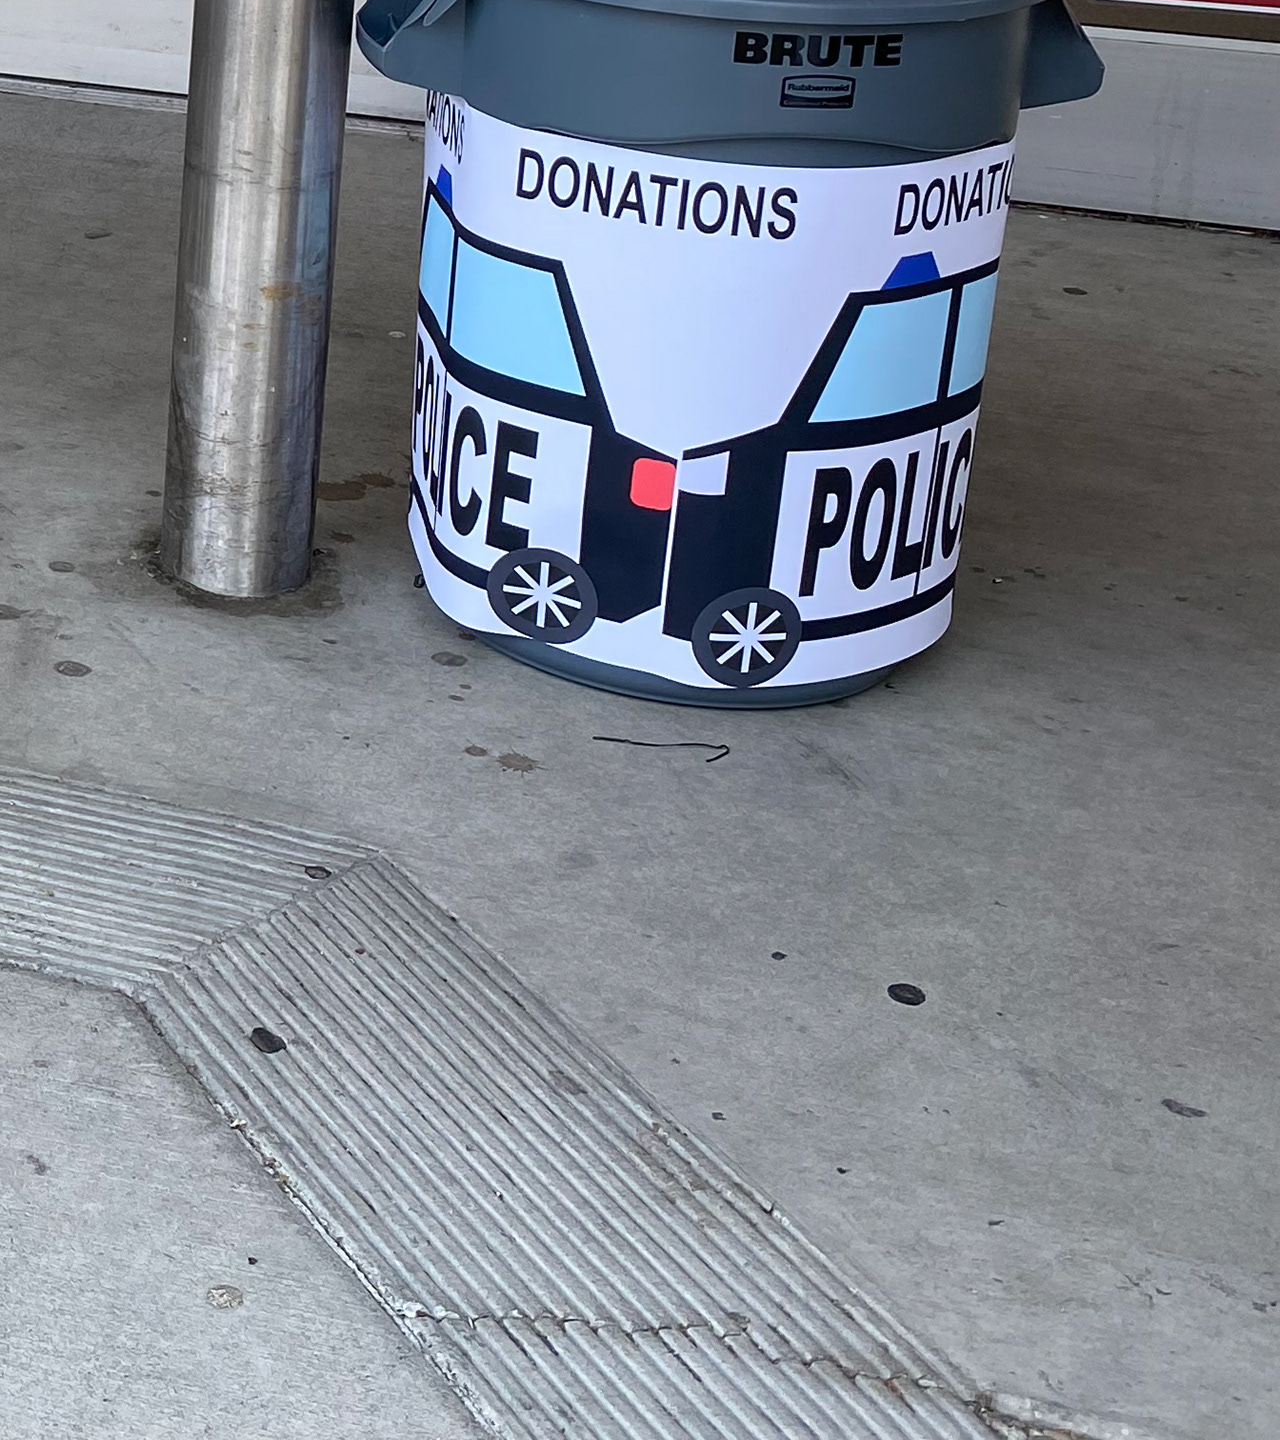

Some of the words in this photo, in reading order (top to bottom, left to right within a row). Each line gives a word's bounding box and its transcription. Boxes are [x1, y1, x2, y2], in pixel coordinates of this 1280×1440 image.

[733, 31, 904, 68] BRUTE
[788, 83, 850, 92] Rubbermaid
[516, 146, 798, 240] DONATIONS
[412, 331, 541, 554] POLICE
